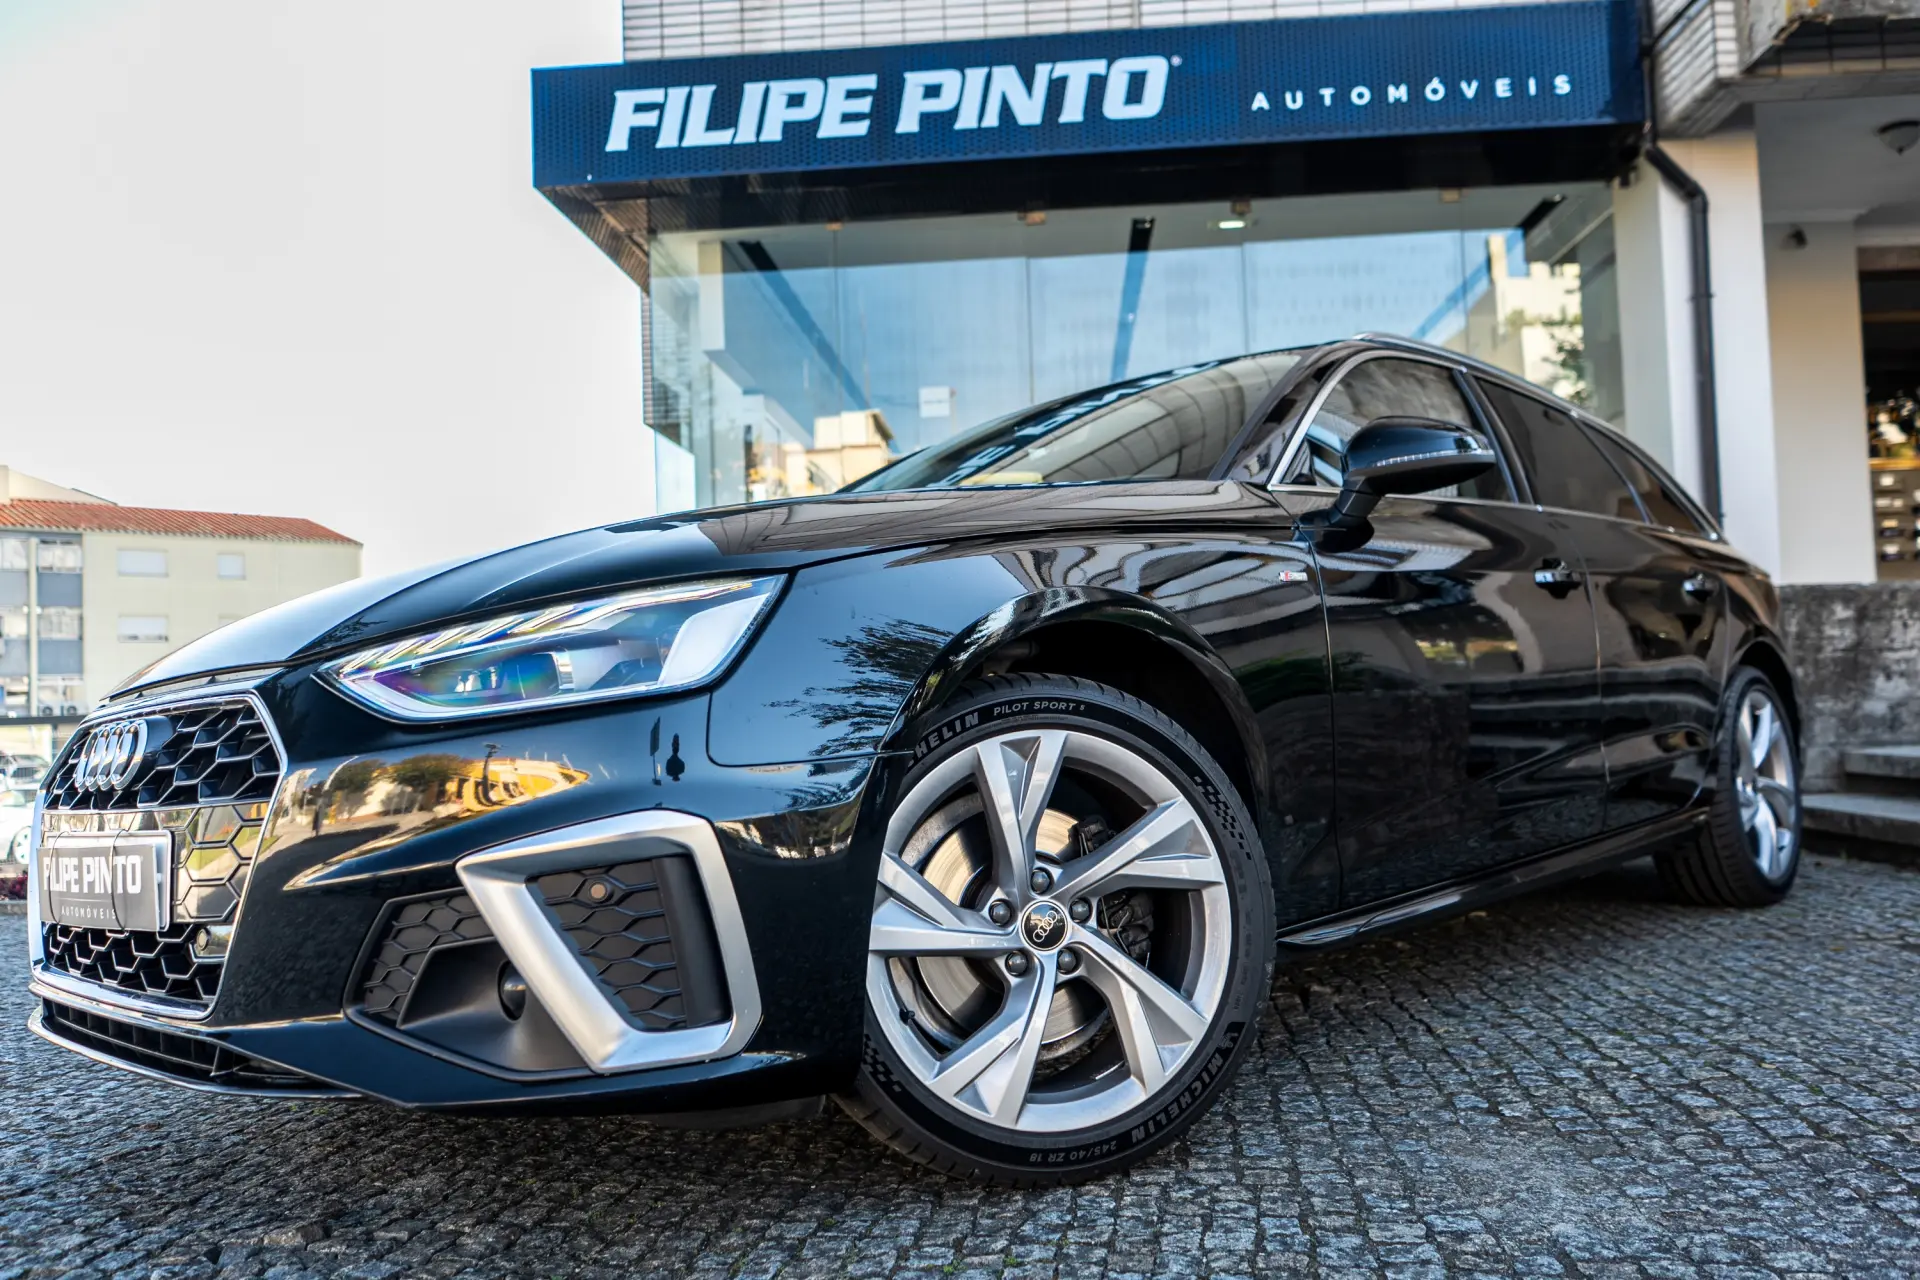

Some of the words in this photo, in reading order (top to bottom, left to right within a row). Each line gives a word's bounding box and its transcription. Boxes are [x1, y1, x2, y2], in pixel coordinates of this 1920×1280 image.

[1251, 74, 1571, 111] AUTOMÓVEIS
[605, 74, 877, 152] FILIPE
[994, 702, 1029, 716] PILOT
[1033, 701, 1076, 711] SPORT
[908, 712, 979, 767] HELIN
[82, 855, 141, 894] PINTO
[1131, 1053, 1224, 1144] MICHELIN
[1029, 1152, 1042, 1162] 18
[1047, 1152, 1065, 1162] ZR
[1069, 1140, 1117, 1160] 245/40
